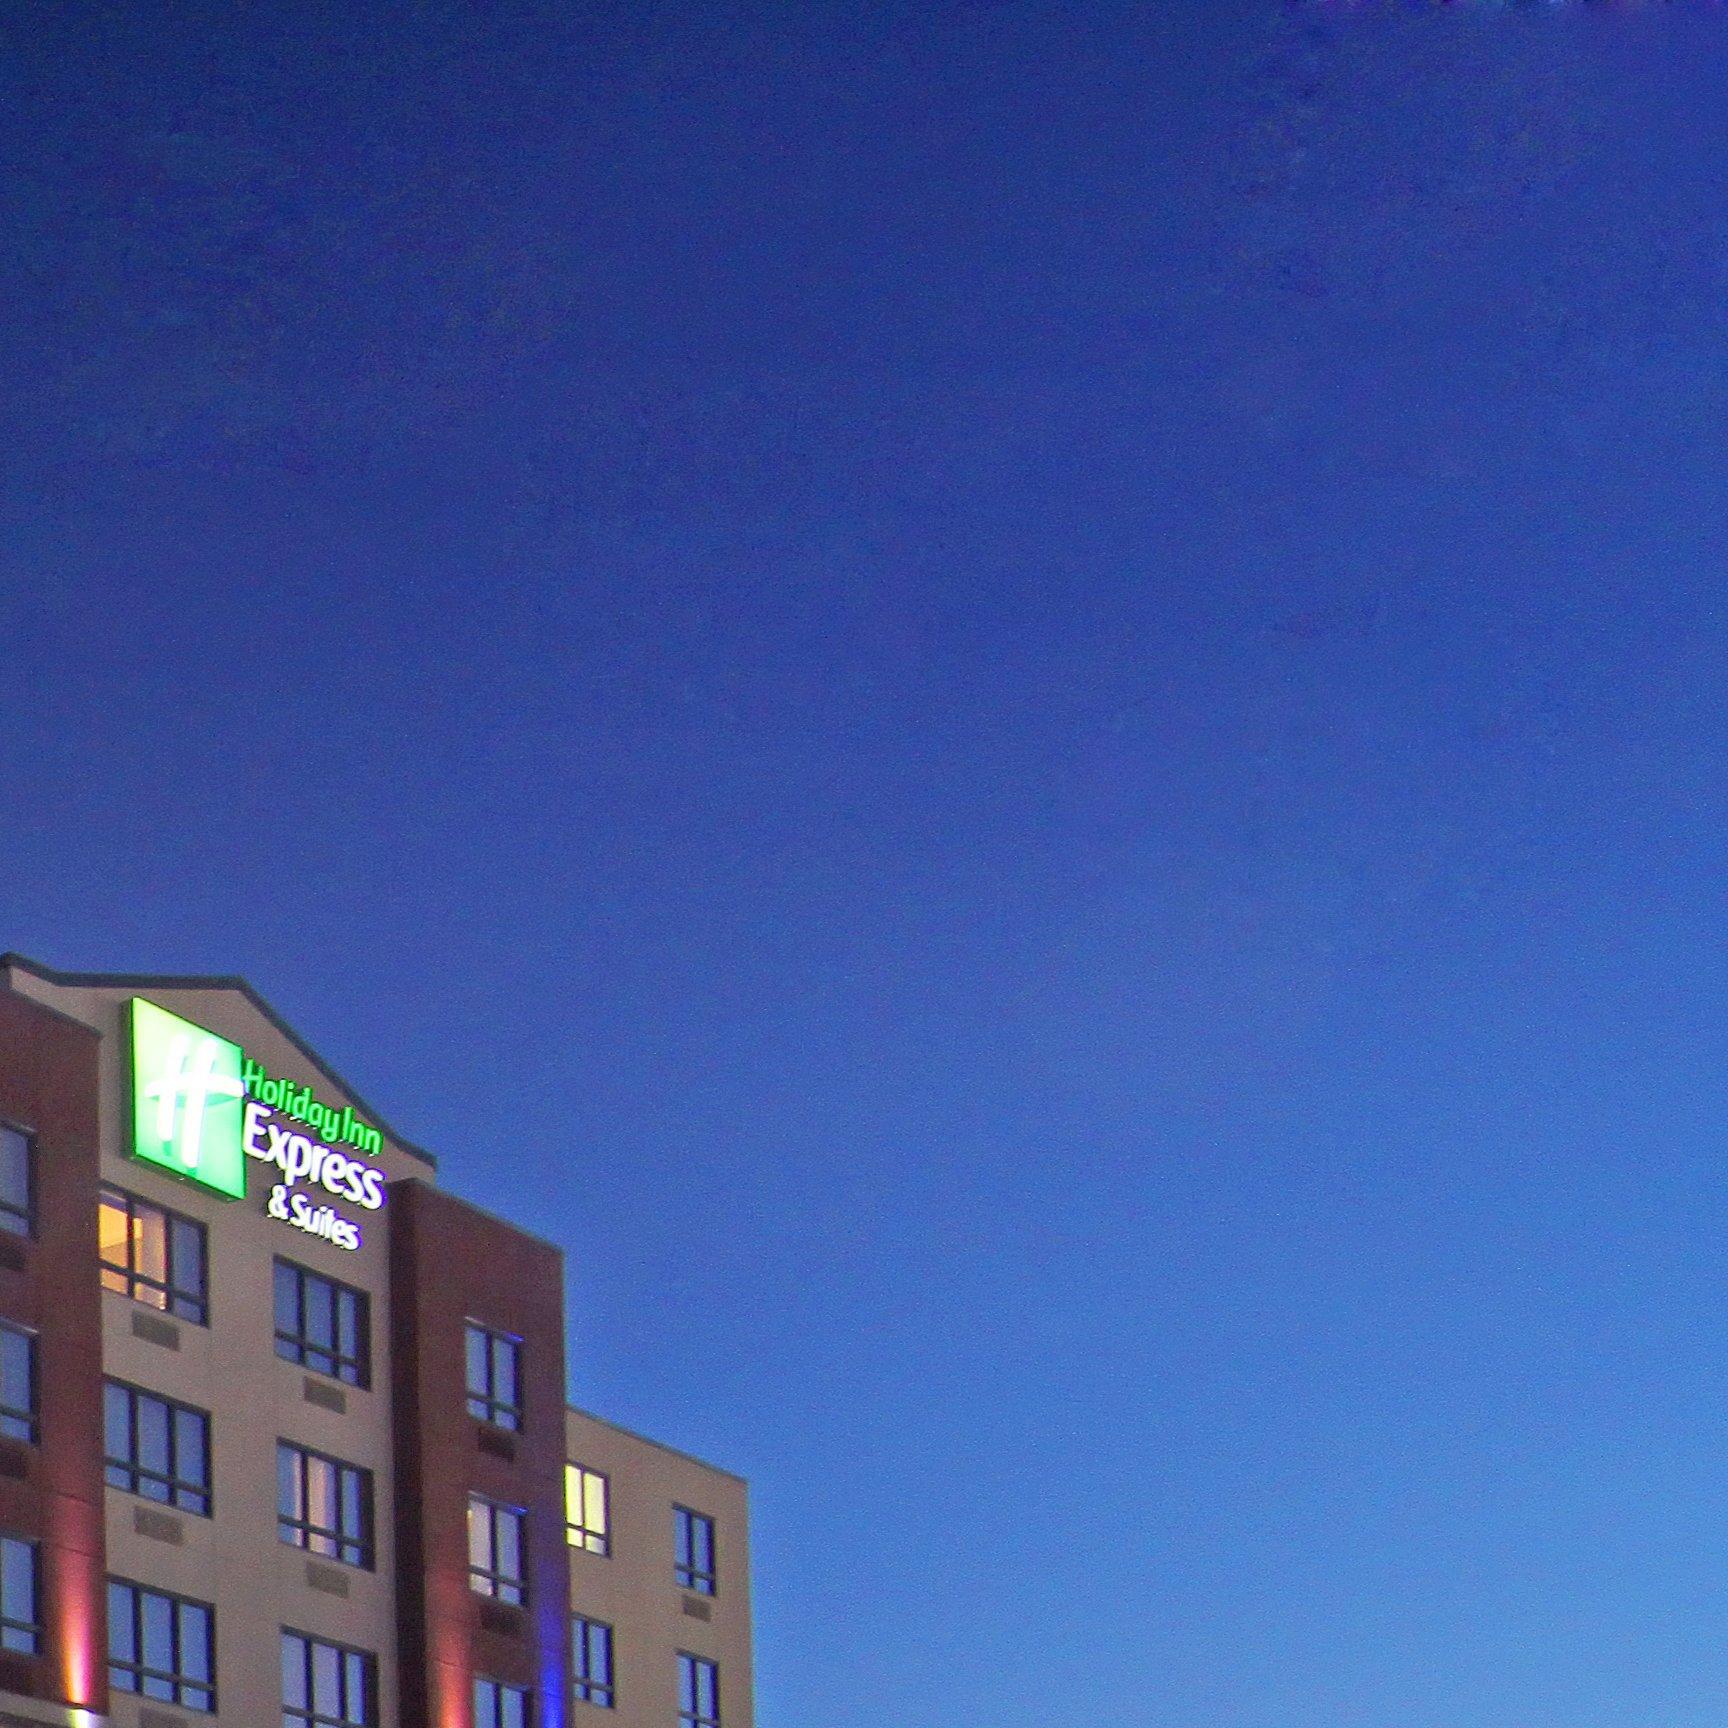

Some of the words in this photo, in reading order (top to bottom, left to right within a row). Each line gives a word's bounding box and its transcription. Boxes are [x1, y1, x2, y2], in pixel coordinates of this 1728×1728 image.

[242, 1058, 341, 1143] Holiday
[341, 1106, 384, 1156] Inn
[242, 1101, 387, 1211] Express
[267, 1184, 290, 1221] &
[290, 1192, 362, 1251] Suites
